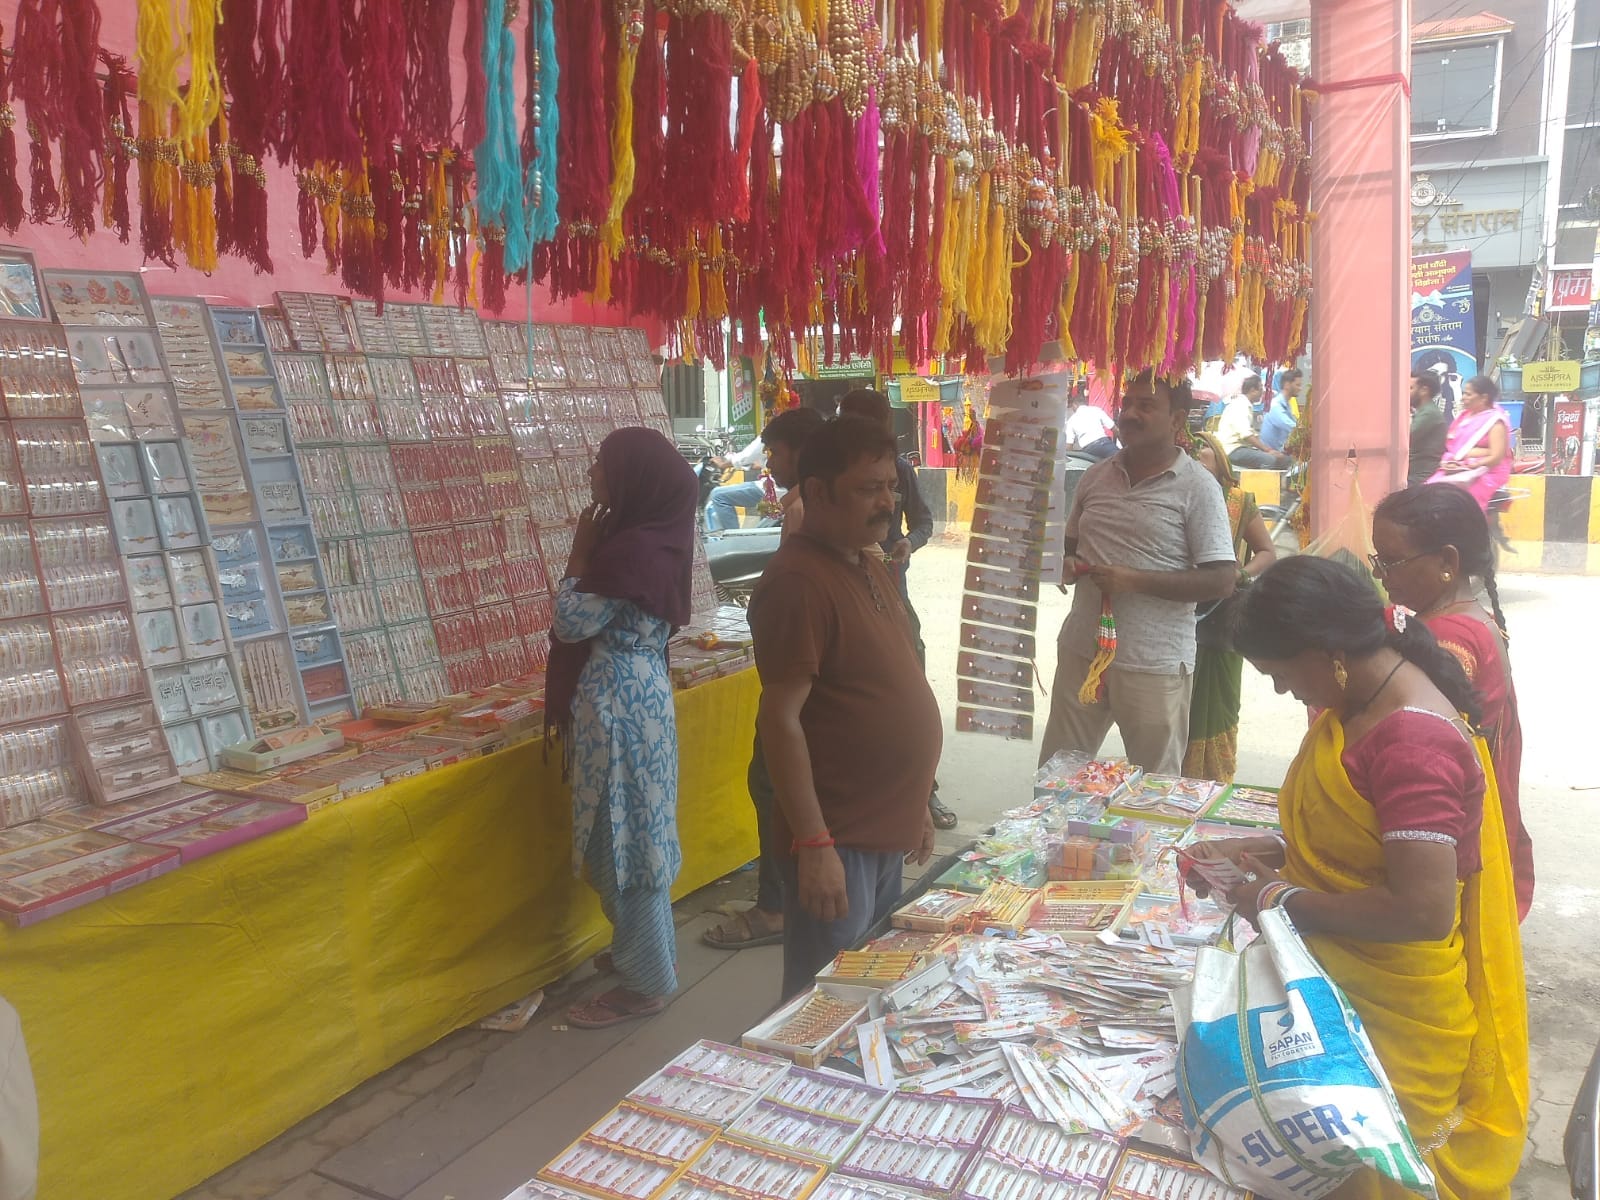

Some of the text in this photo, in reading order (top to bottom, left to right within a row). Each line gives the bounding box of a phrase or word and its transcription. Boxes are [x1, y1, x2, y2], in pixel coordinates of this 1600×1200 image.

[1439, 205, 1521, 234] संतराम
[1433, 321, 1463, 332] संतराम
[1269, 1031, 1313, 1054] SAPAN
[1241, 1103, 1352, 1168] SUPER
